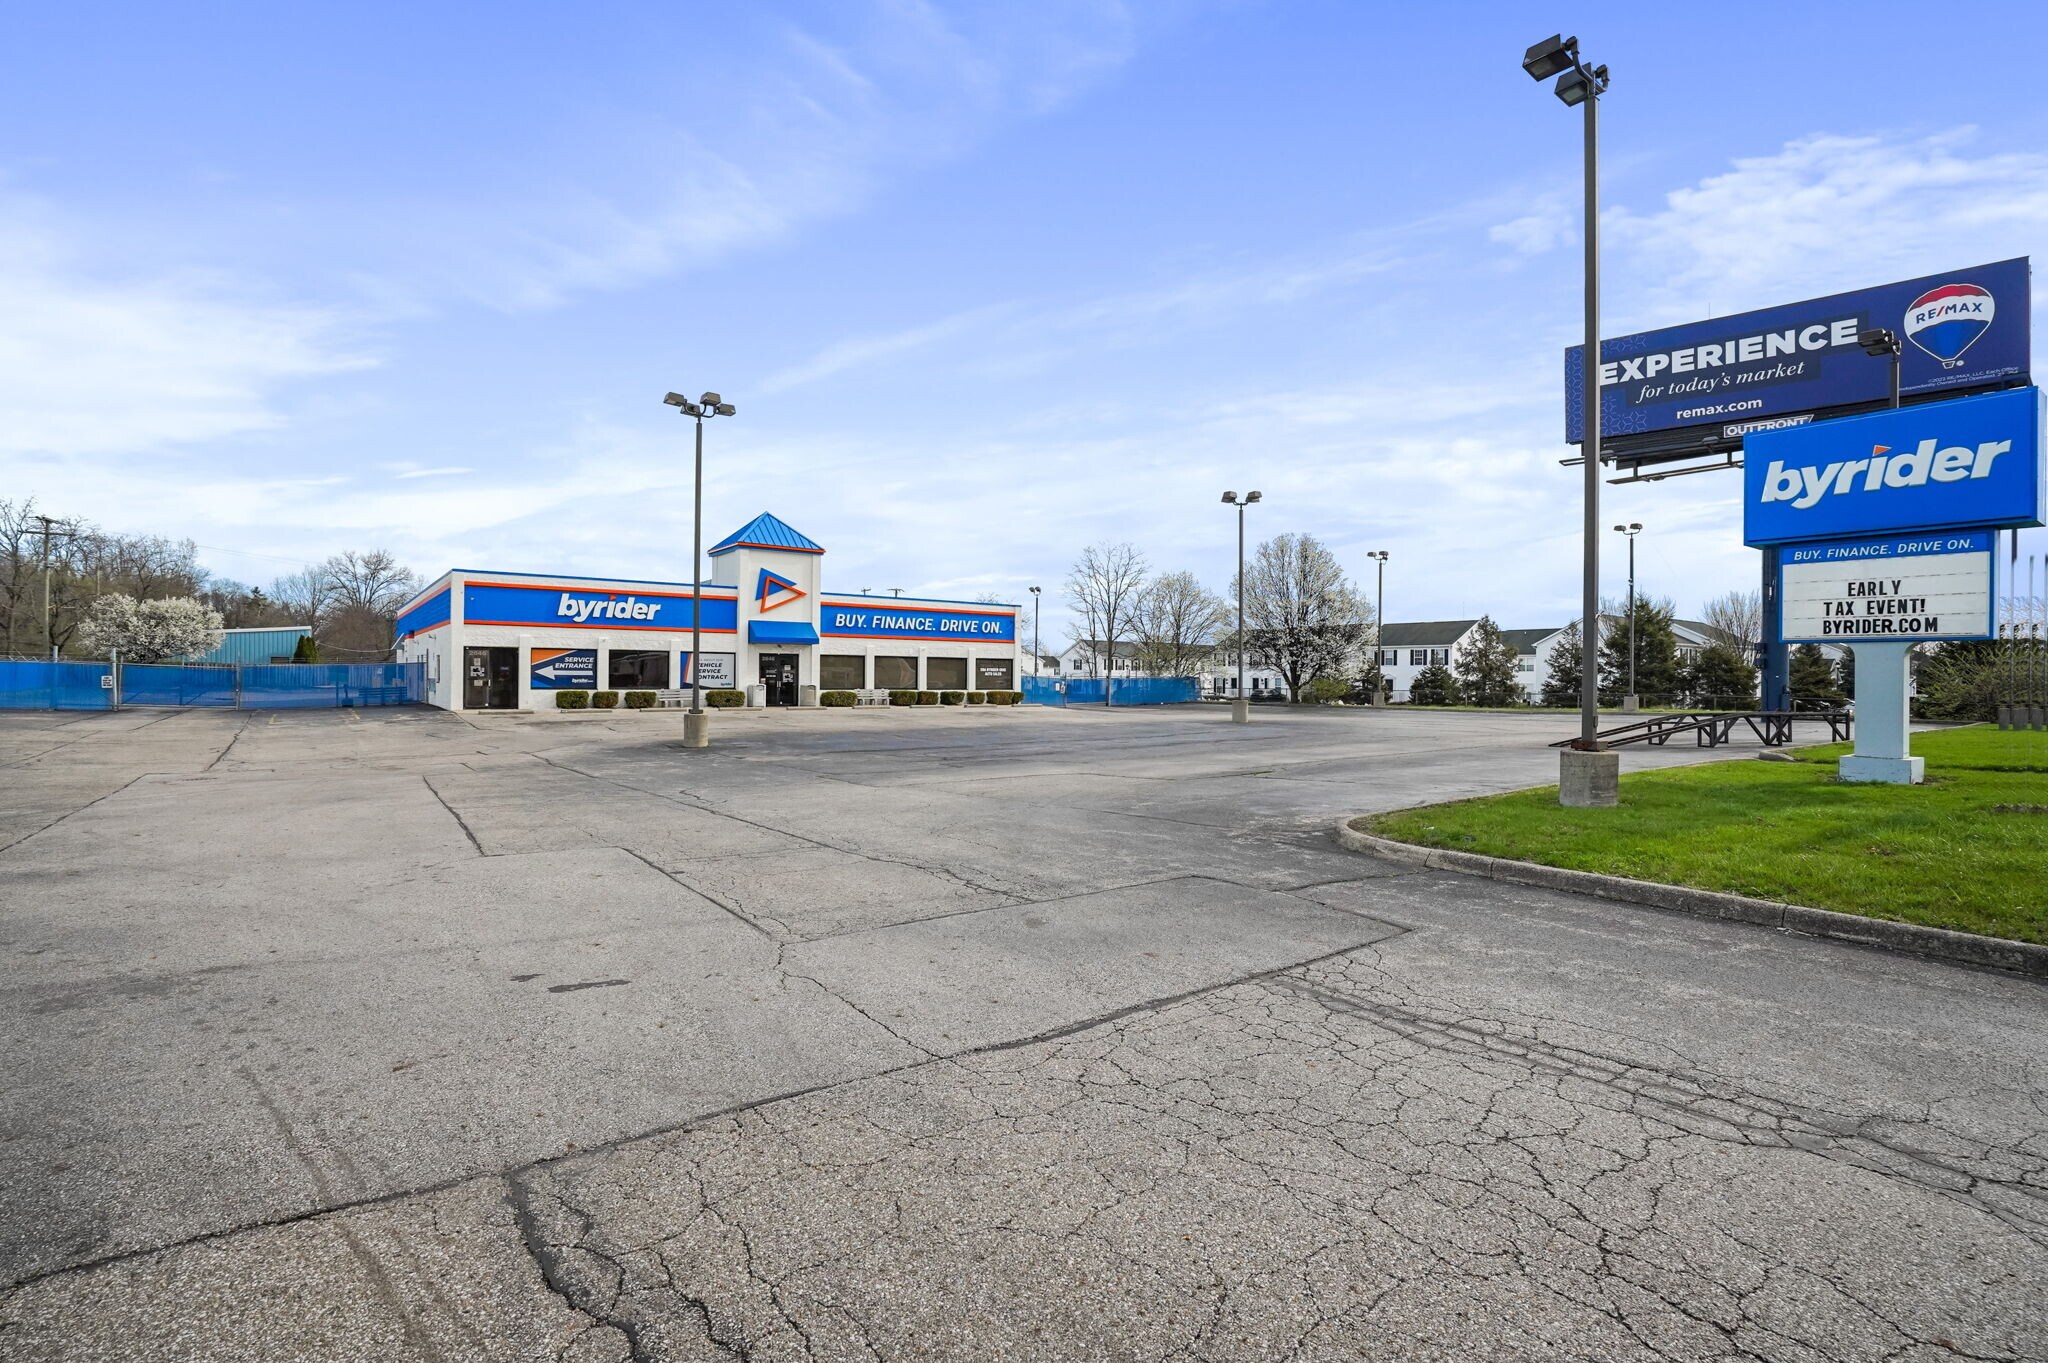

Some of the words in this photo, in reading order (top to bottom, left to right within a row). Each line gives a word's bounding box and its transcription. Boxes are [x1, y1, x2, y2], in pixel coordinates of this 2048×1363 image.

[1916, 303, 1983, 324] RE/MAX
[1599, 318, 1859, 386] EXPERIENCE
[1636, 384, 1664, 404] for
[1668, 372, 1731, 395] today’s
[1735, 360, 1805, 385] market
[1676, 399, 1763, 420] remax.com
[1727, 417, 1808, 436] OUTFRONT
[1761, 438, 2012, 509] byrider
[1794, 550, 1821, 561] BUY.
[1827, 545, 1891, 558] FINANCE.
[1897, 540, 1943, 554] DRIVE
[1947, 539, 1974, 550] ON.
[1847, 580, 1901, 597] EARLY
[557, 593, 661, 623] byrider
[1823, 601, 1855, 616] TAX
[1866, 599, 1926, 615] EVENT!
[835, 613, 867, 628] BUY.
[872, 615, 936, 631] FINANCE.
[940, 619, 978, 633] DRIVE
[981, 621, 1003, 634] ON.
[1823, 617, 1938, 635] BYRIDER.COM
